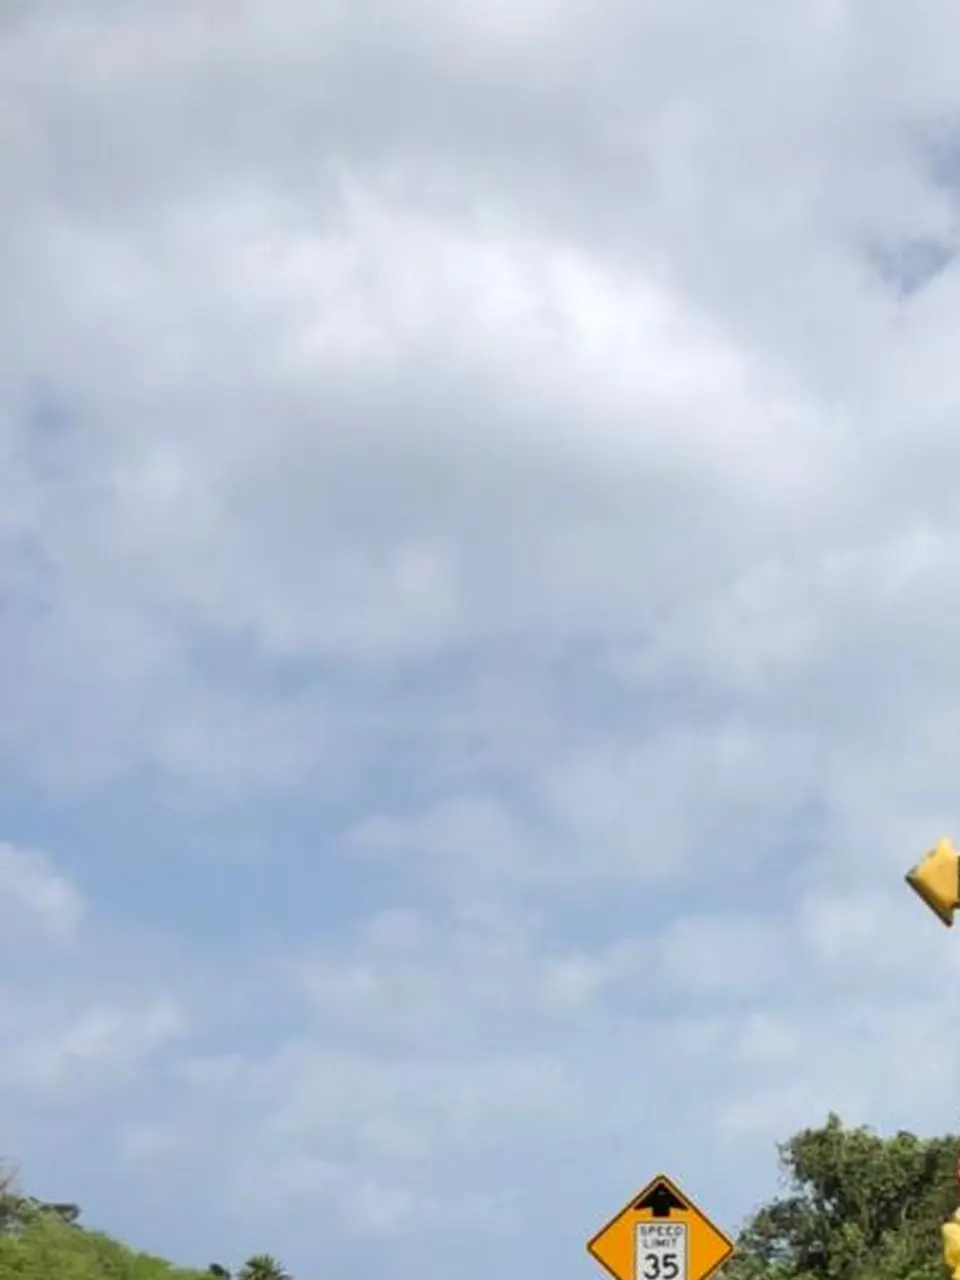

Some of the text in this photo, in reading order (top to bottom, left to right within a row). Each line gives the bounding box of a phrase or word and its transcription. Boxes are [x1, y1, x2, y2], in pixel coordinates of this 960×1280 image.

[639, 1225, 684, 1237] SPEED
[644, 1238, 677, 1249] LIMIT
[644, 1253, 679, 1280] 35
